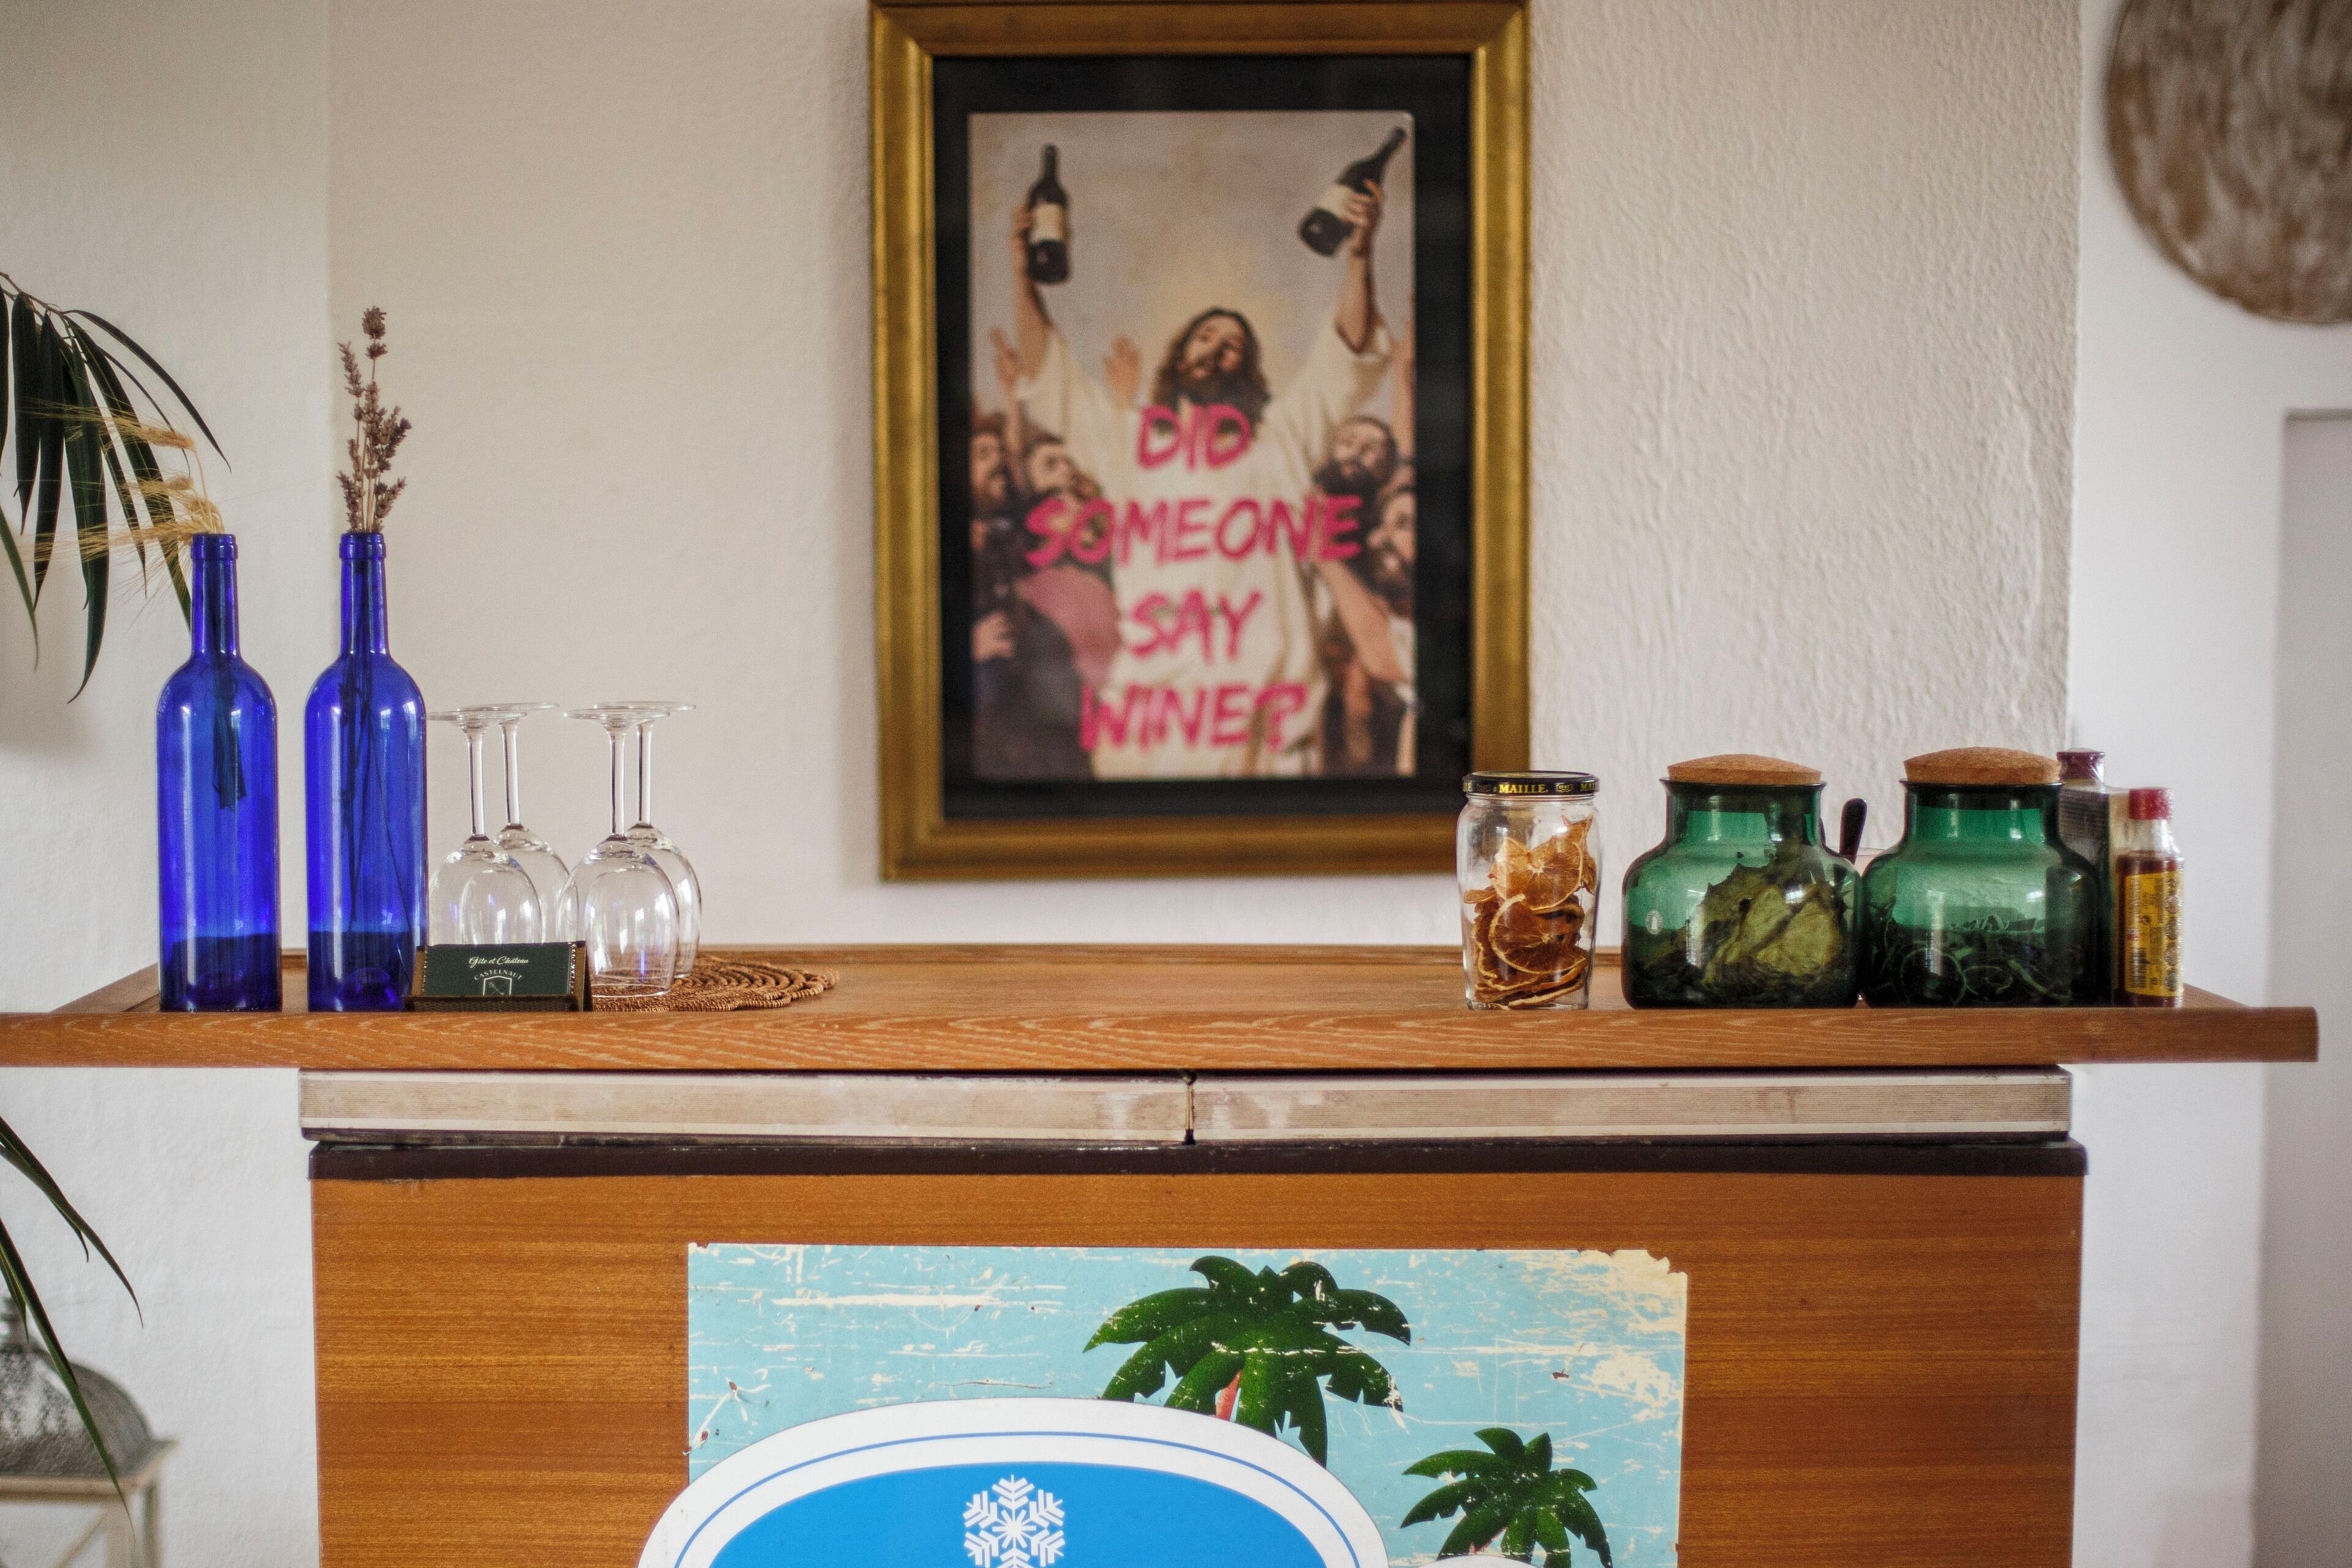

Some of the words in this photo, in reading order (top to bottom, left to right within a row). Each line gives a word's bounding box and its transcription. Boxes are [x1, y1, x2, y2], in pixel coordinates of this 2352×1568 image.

[1136, 402, 1253, 471] DID
[1025, 494, 1363, 567] SOMEONE
[1130, 589, 1264, 665] SAY
[1079, 682, 1307, 753] WINE?
